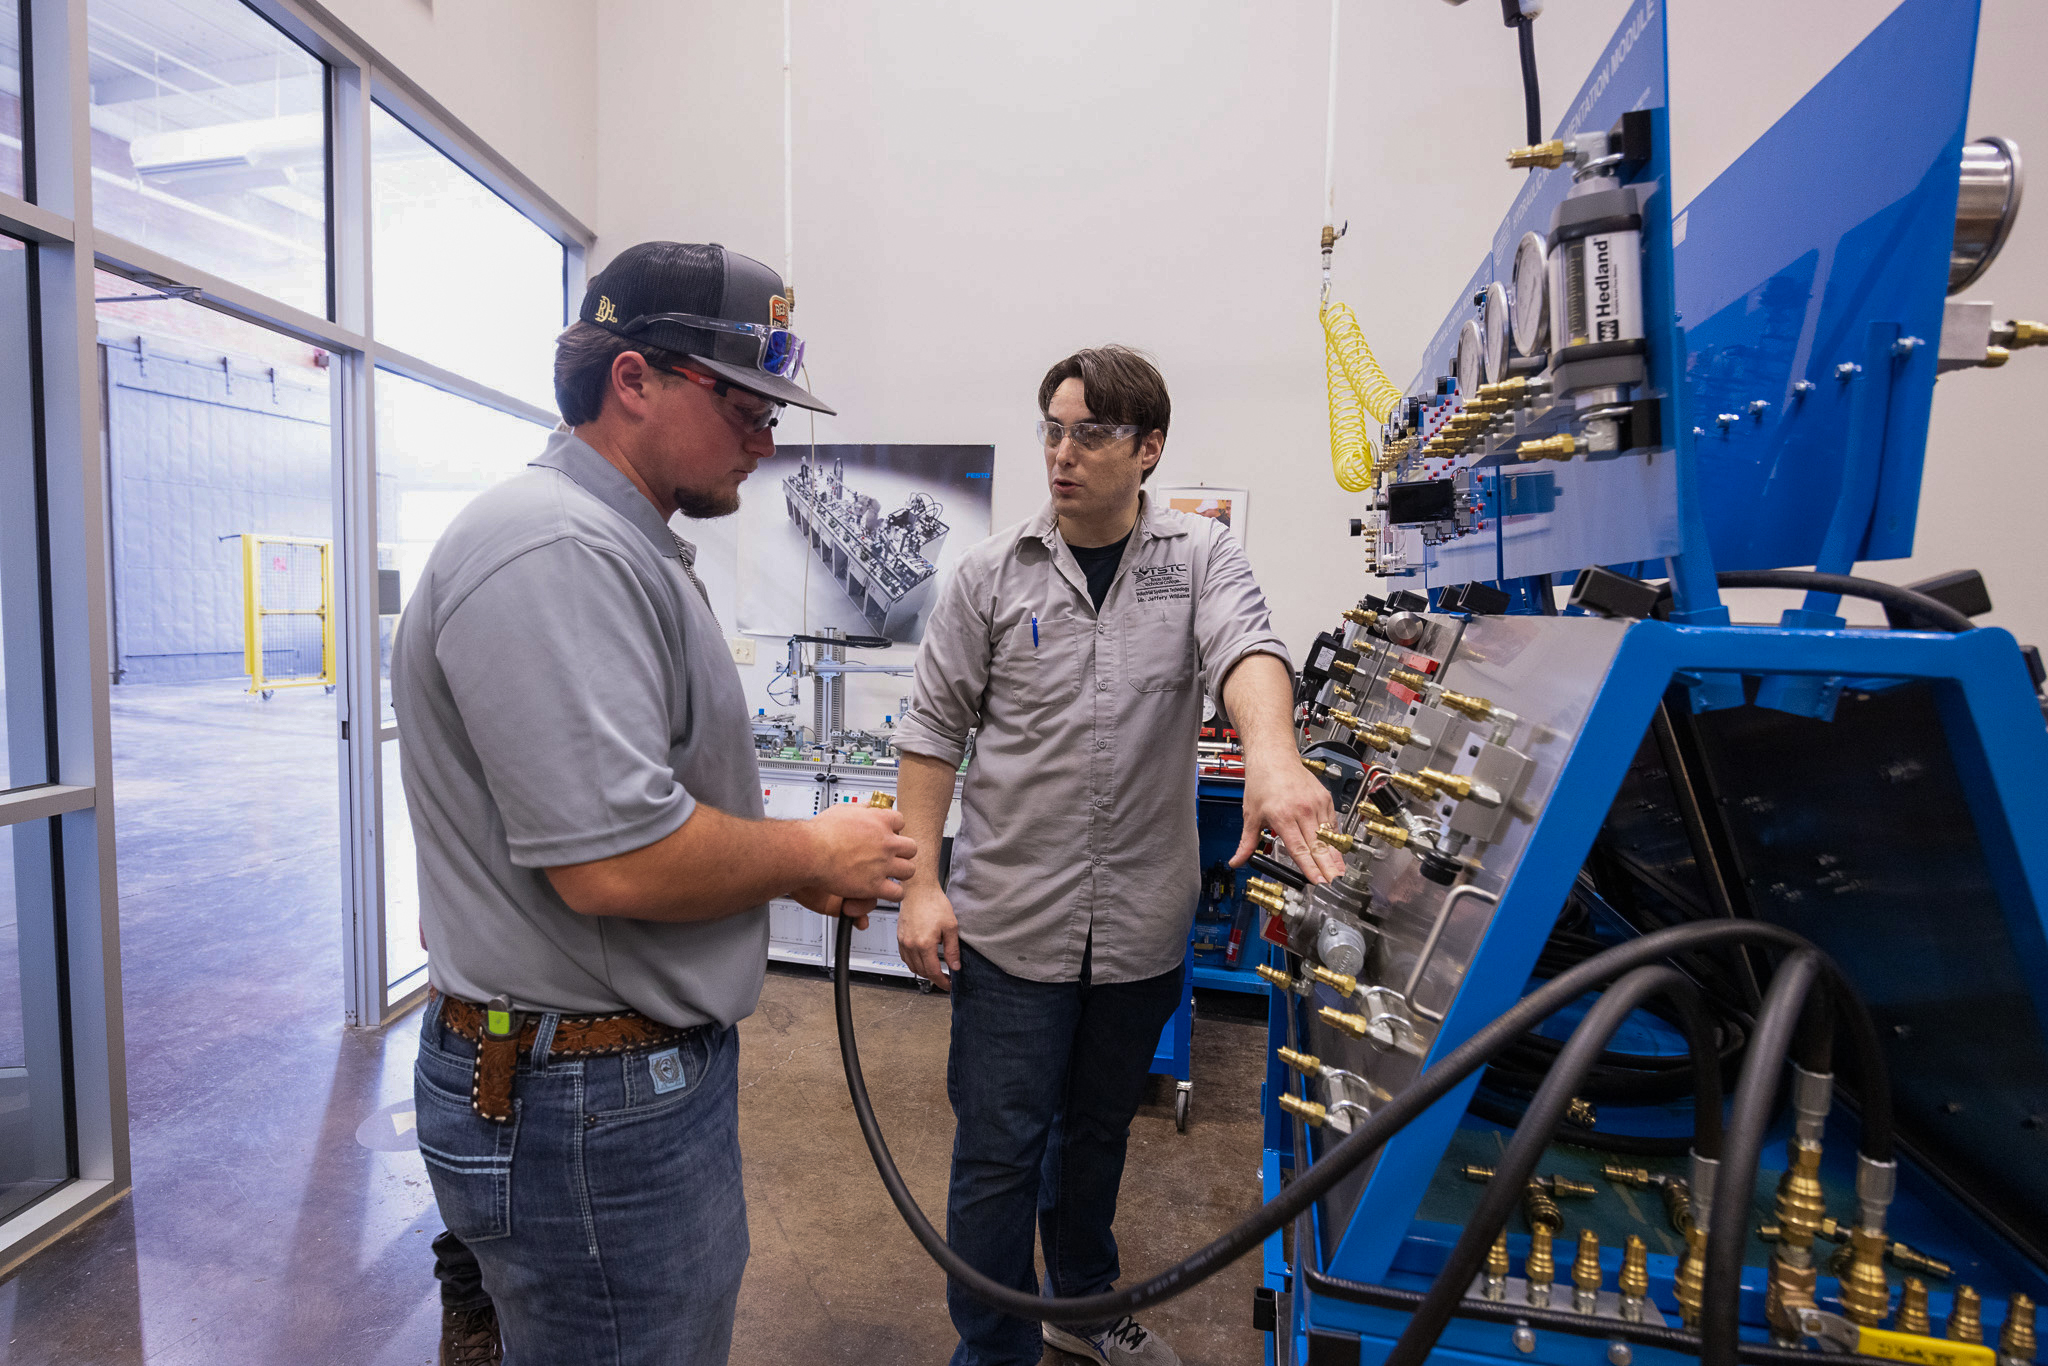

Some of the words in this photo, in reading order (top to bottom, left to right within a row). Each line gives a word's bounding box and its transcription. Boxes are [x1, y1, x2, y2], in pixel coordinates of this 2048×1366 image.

[1611, 0, 1655, 77] MODULE
[1594, 240, 1610, 317] Hedland
[1147, 563, 1187, 575] TSTC
